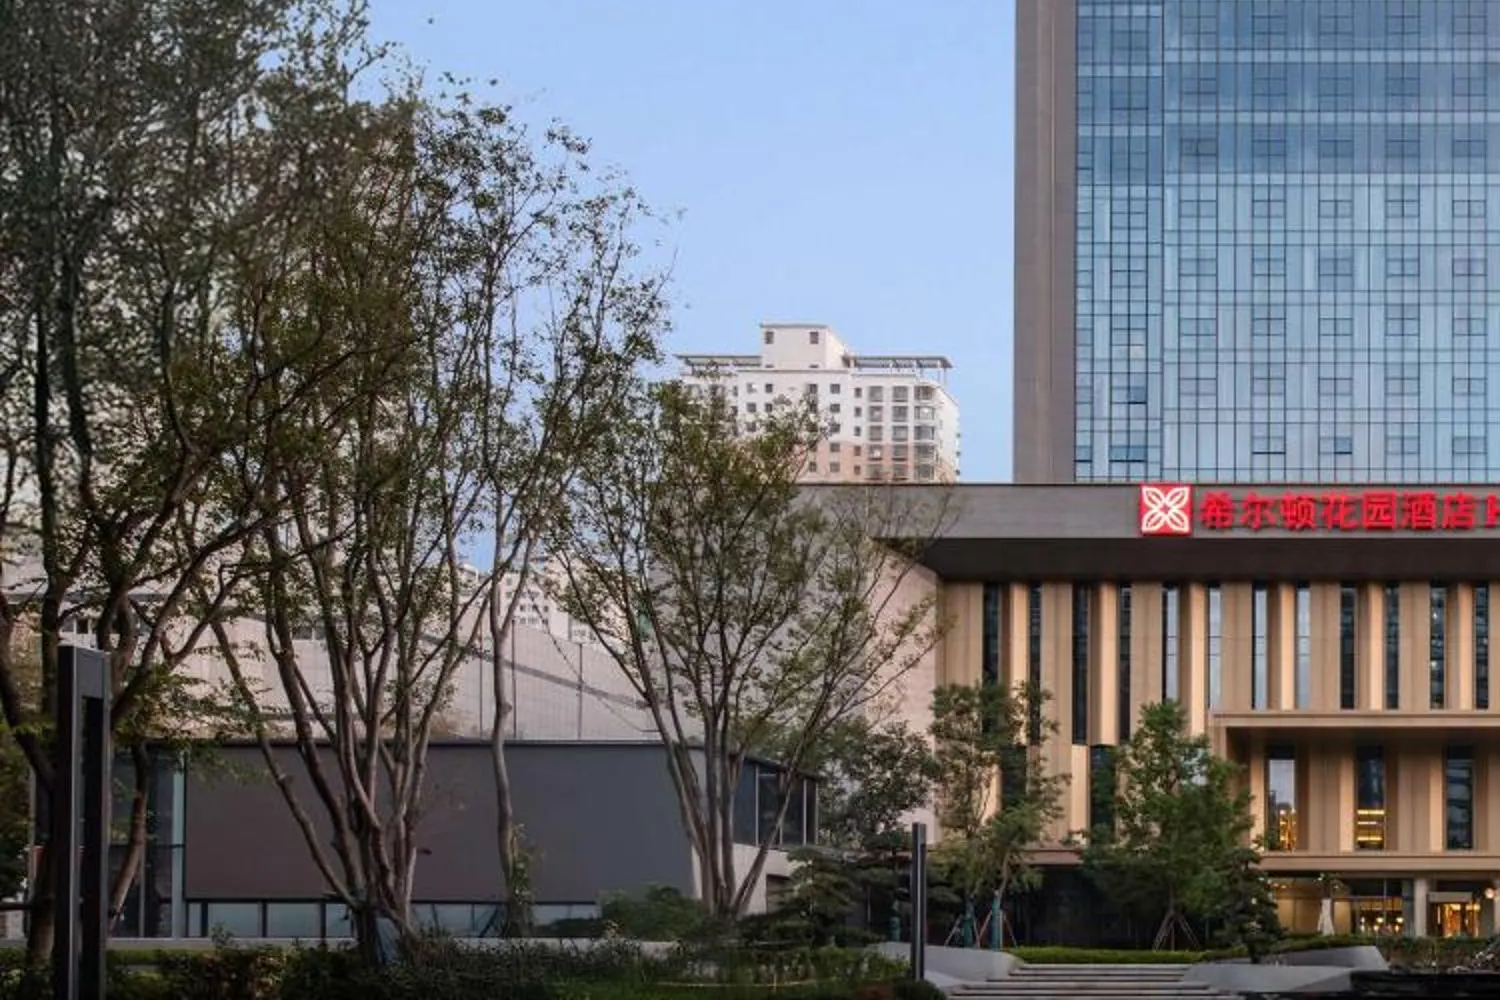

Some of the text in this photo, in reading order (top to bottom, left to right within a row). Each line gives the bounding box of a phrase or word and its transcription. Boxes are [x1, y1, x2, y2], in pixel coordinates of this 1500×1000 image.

[1199, 491, 1476, 530] 希尔顿花园酒店
